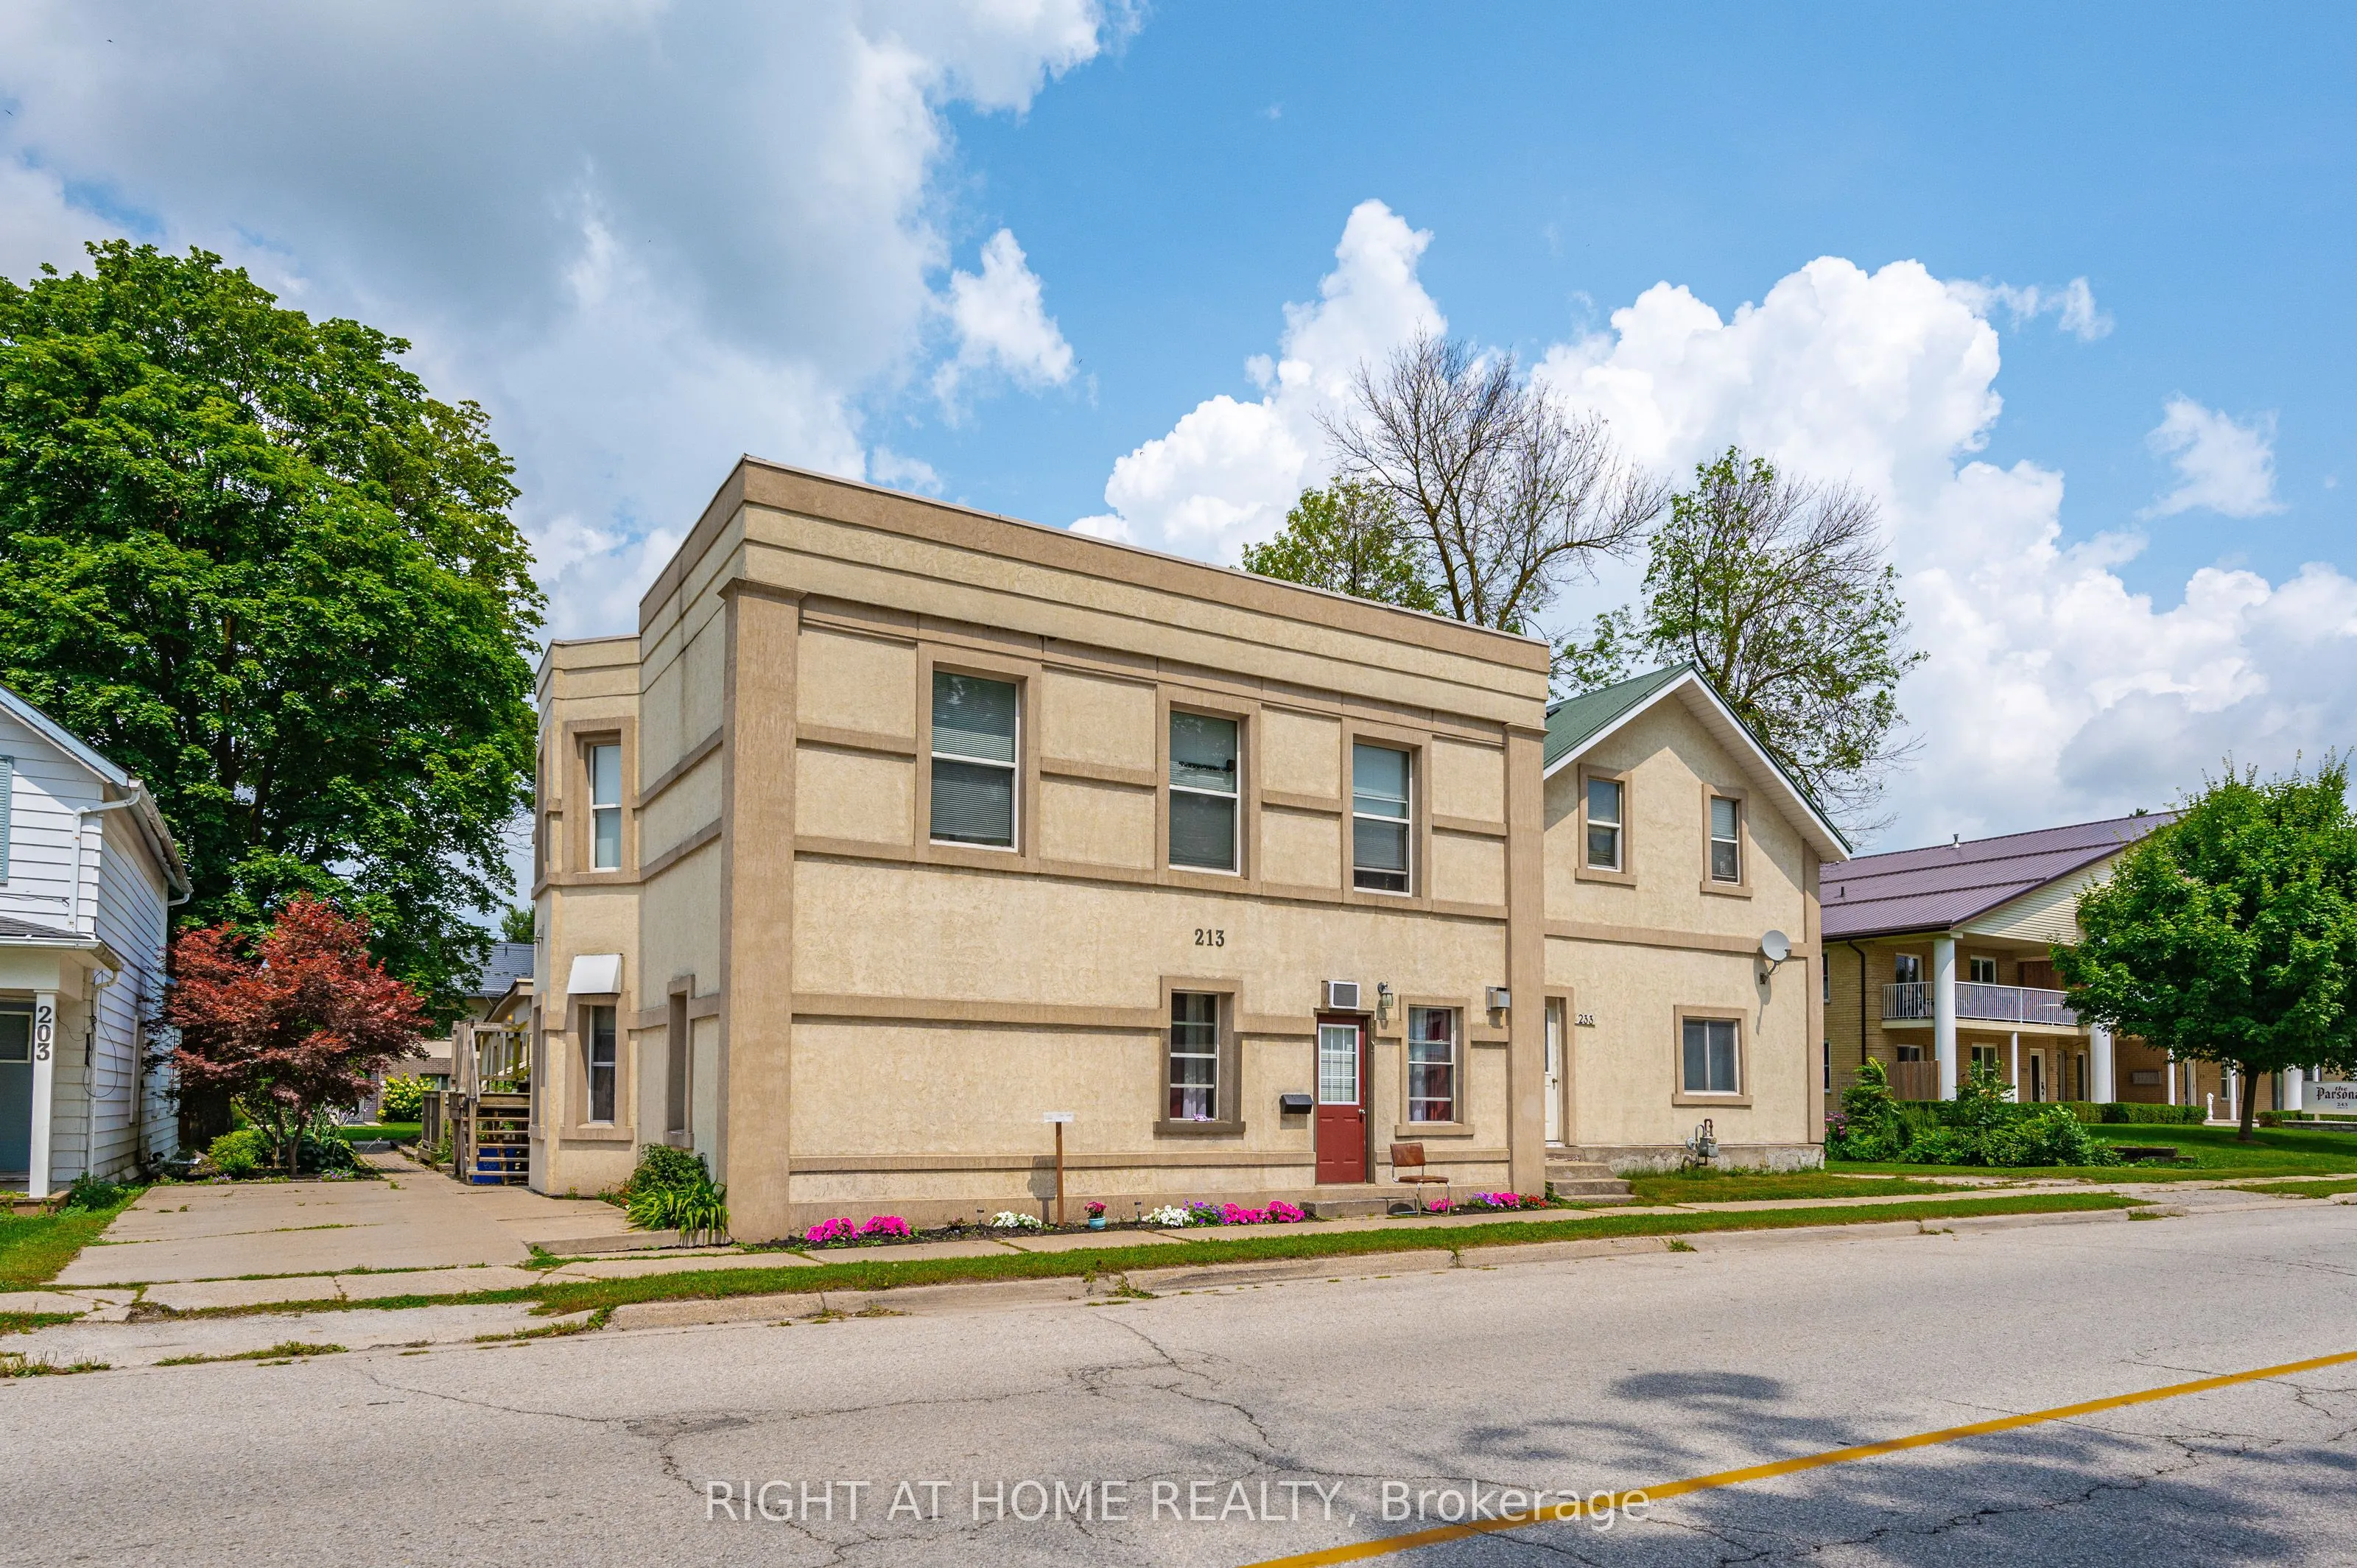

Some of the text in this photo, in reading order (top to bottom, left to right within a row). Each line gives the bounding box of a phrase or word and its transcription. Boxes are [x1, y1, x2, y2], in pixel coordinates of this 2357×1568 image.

[1195, 928, 1225, 947] 213
[1578, 1014, 1594, 1024] 233
[36, 1005, 52, 1061] 203
